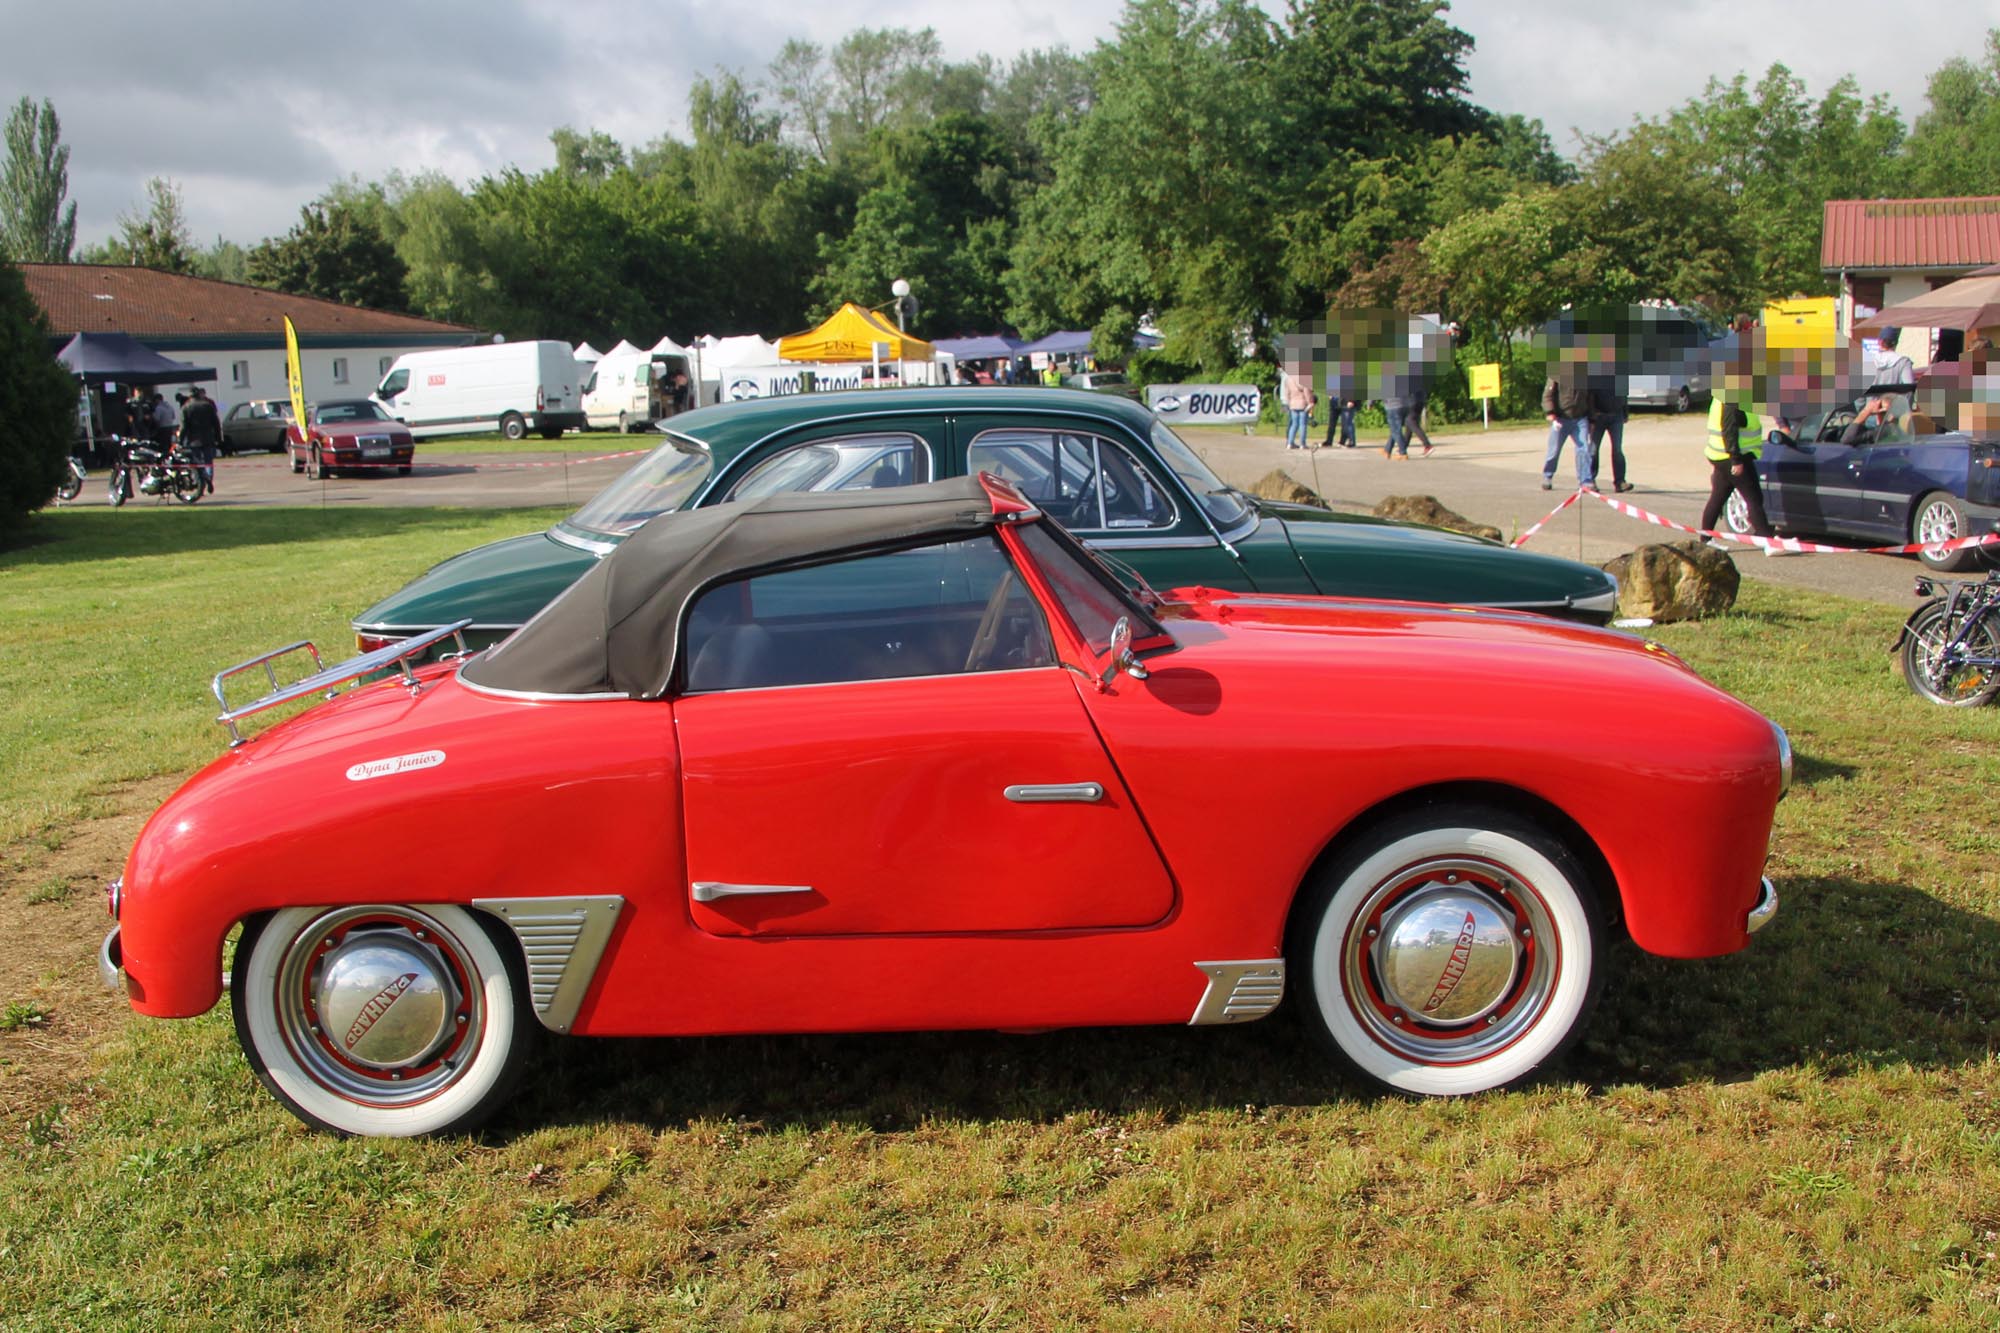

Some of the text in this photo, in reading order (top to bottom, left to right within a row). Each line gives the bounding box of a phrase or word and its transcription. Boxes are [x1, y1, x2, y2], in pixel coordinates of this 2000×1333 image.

[769, 376, 860, 398] INSCPTIONS
[1189, 393, 1258, 415] BOURSE
[354, 753, 438, 776] Dyna Junior
[1430, 921, 1475, 1008] PANHARD
[347, 976, 411, 1044] PANHARD
